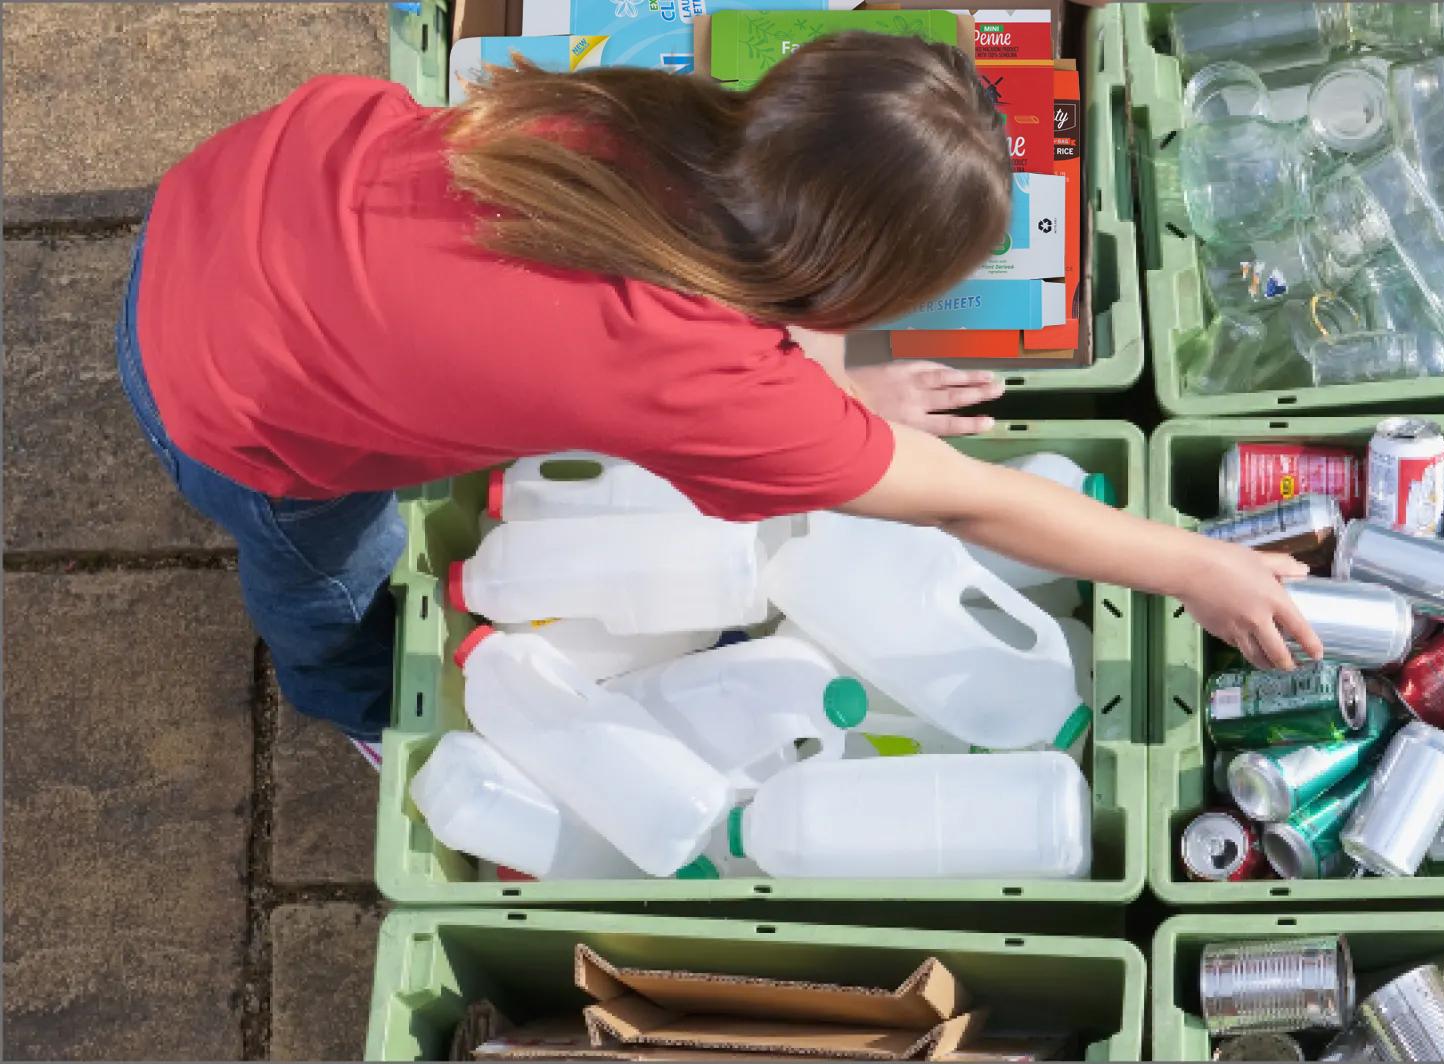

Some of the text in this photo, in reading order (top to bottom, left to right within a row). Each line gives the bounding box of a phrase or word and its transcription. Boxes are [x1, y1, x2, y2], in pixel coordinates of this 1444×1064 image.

[572, 38, 588, 55] NEW
[1056, 147, 1074, 155] RICE
[937, 295, 982, 310] SHEETS
